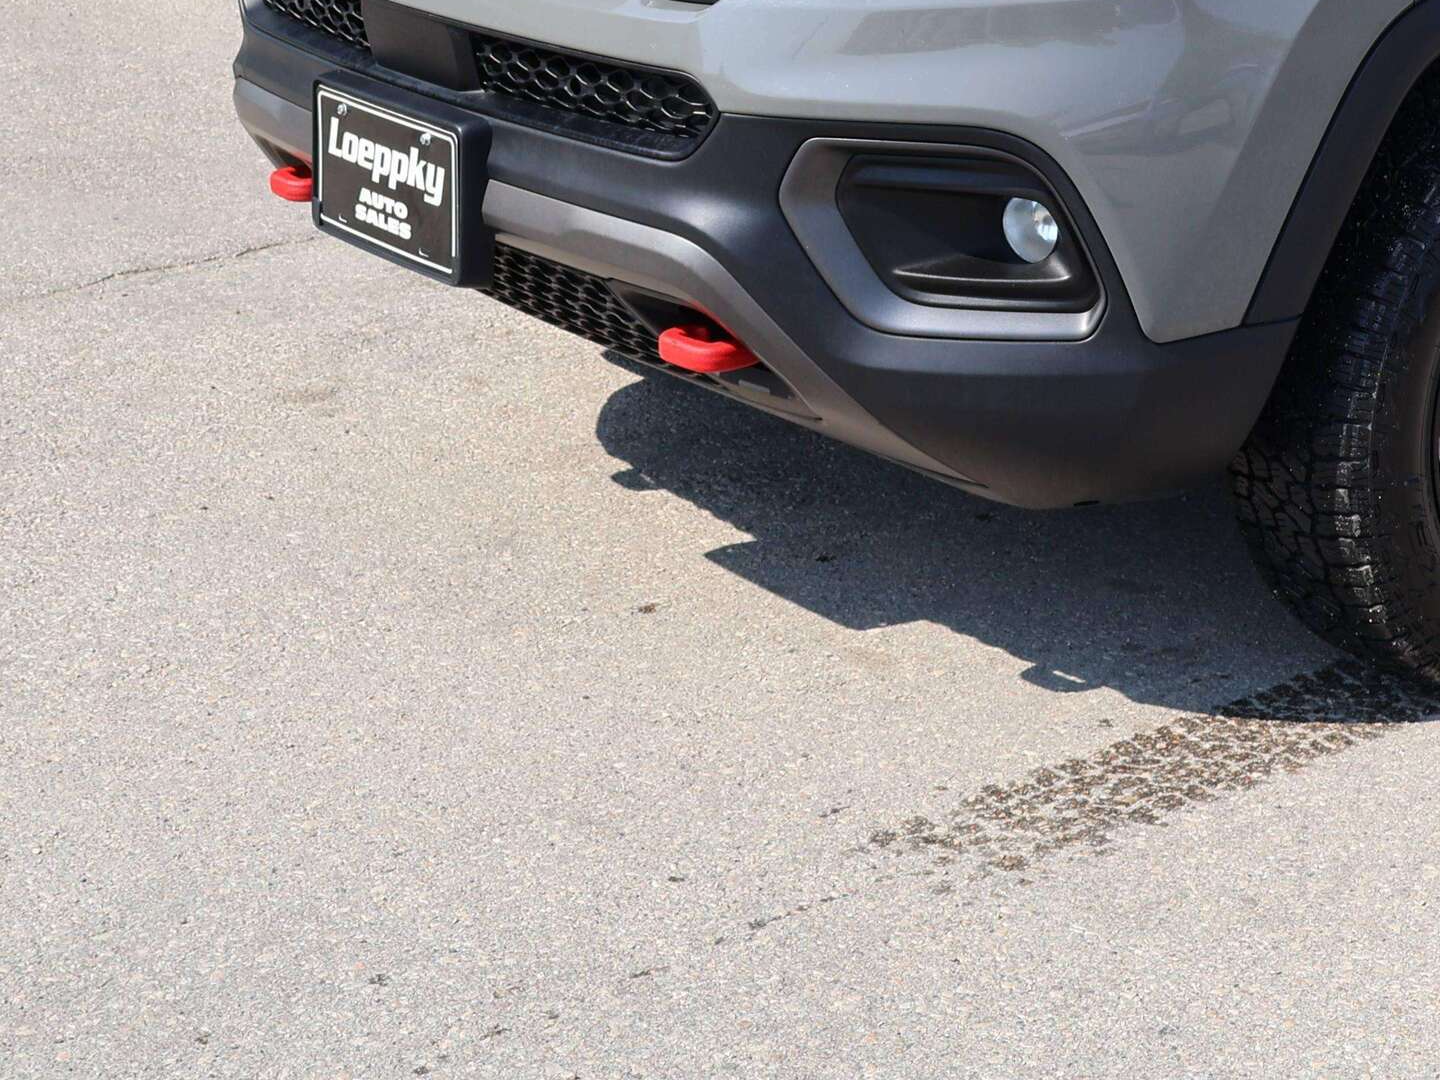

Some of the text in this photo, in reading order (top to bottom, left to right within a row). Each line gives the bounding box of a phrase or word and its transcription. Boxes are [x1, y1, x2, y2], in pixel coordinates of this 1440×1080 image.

[328, 116, 445, 207] Loeppky
[354, 203, 412, 240] SALES
[358, 187, 408, 220] AUTO
